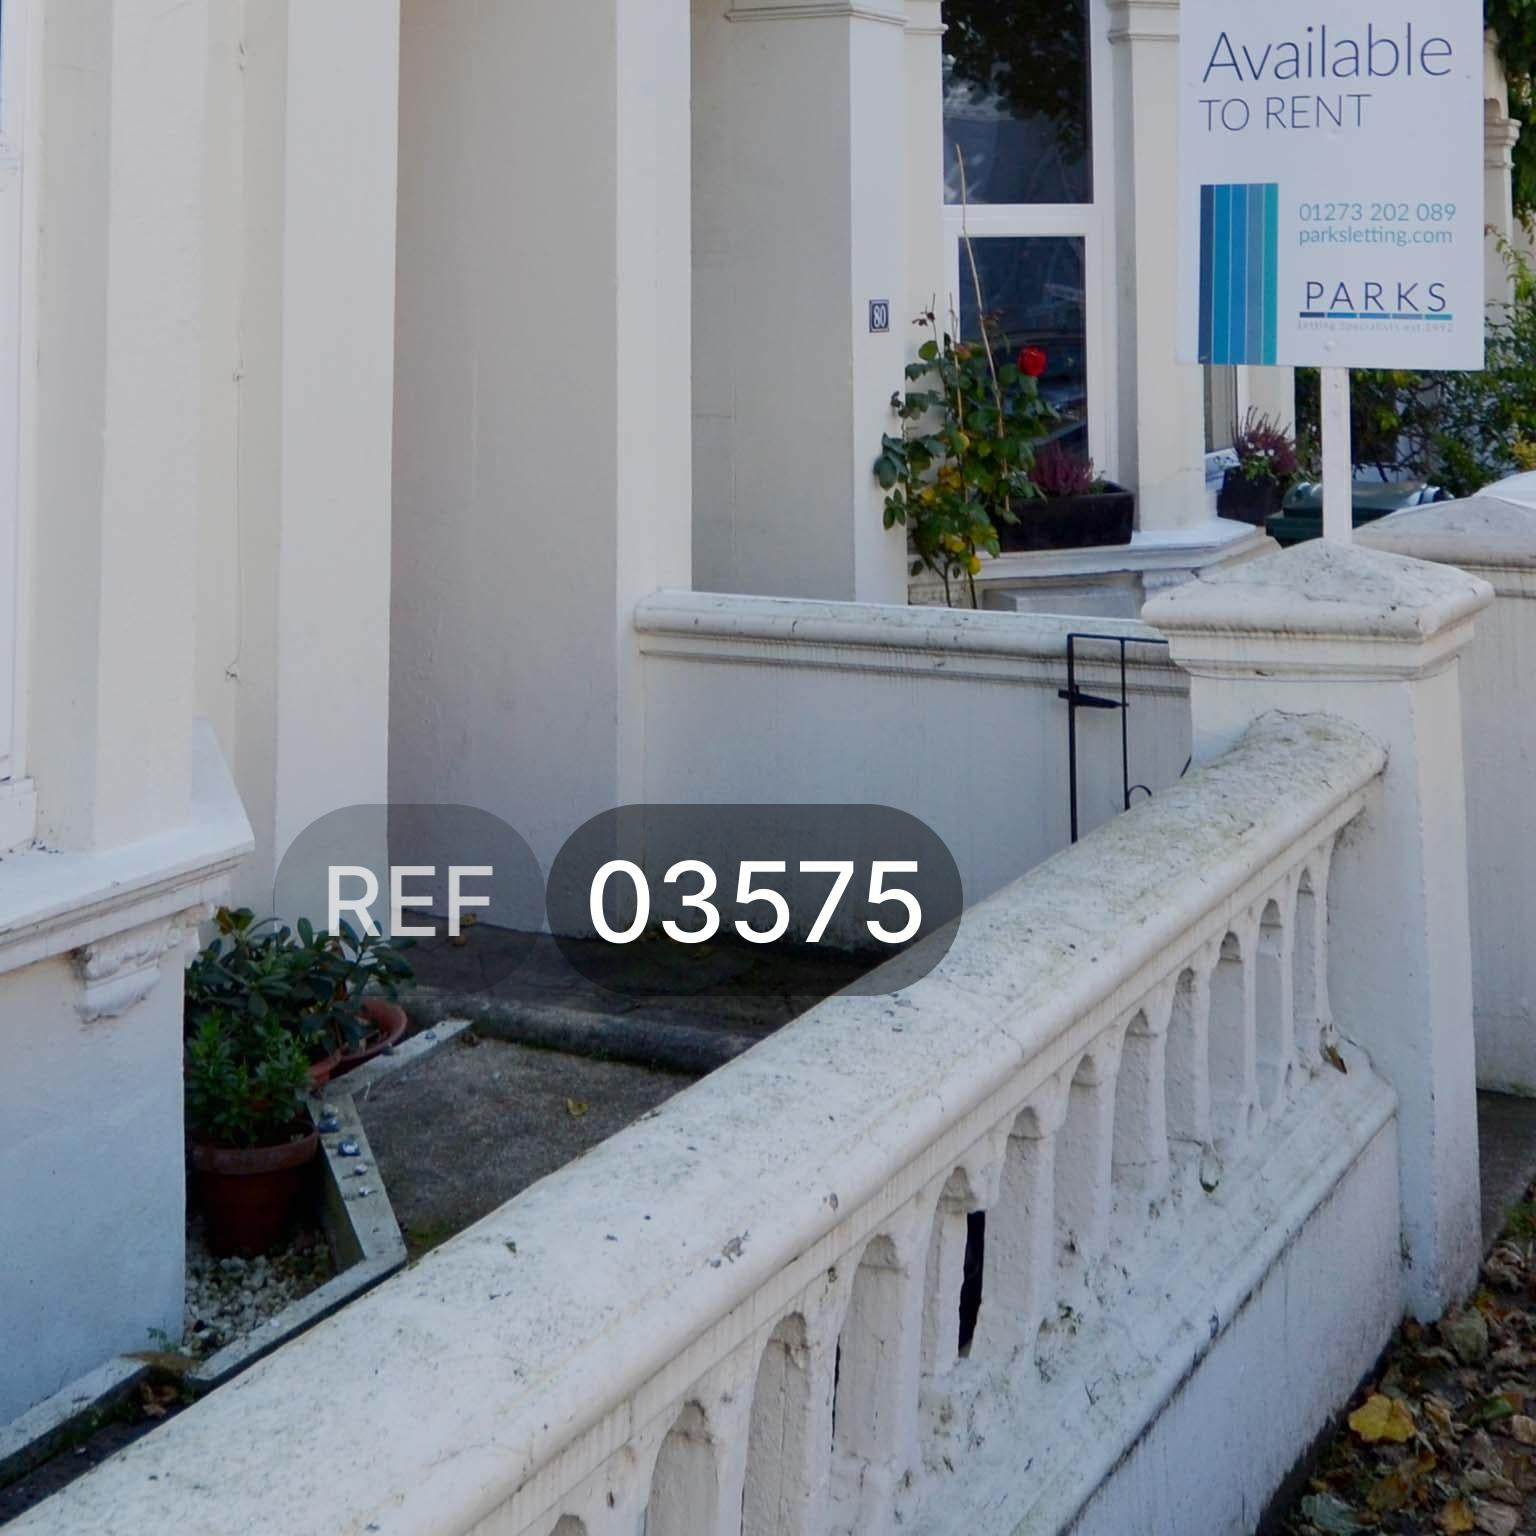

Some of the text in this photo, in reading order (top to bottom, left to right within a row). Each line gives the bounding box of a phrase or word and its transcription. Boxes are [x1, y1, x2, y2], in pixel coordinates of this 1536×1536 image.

[1202, 21, 1453, 83] Available
[1198, 93, 1373, 132] TO RENT
[1298, 202, 1457, 222] 01273 202 089
[1298, 225, 1453, 247] parksletting.com
[1306, 280, 1447, 312] PARKS
[872, 304, 887, 328] 80
